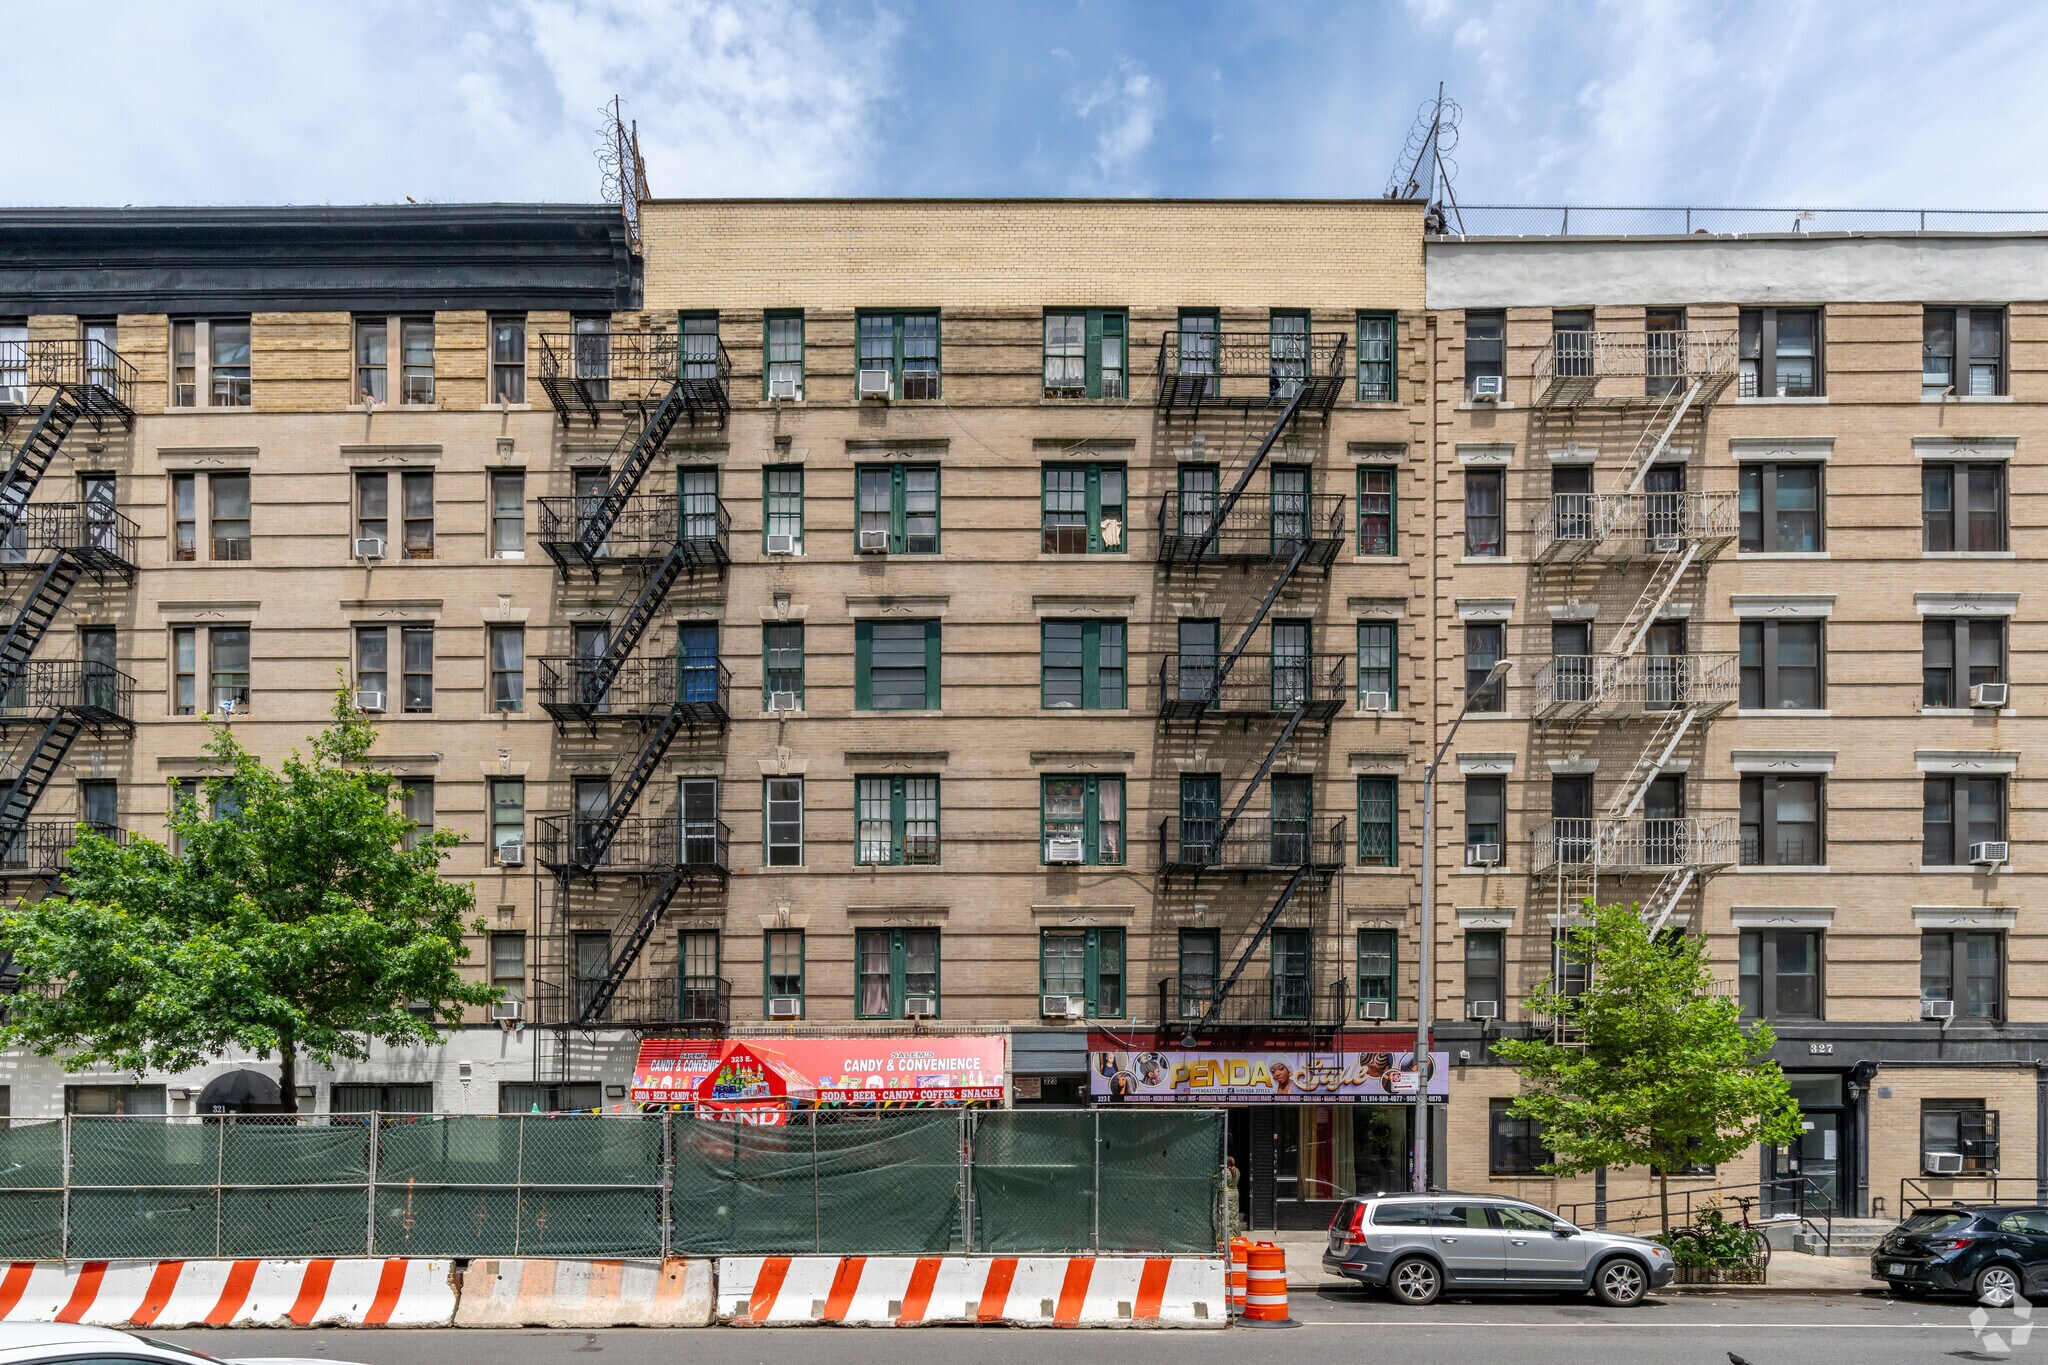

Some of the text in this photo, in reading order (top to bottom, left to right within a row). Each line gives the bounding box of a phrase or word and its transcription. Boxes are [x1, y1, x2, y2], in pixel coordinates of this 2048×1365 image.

[1810, 1044, 1833, 1053] 327
[650, 1060, 676, 1072] CANDY
[676, 1060, 682, 1072] &
[844, 1057, 981, 1072] CANDY & CONVENIENCE
[1169, 1059, 1274, 1089] PENDA
[1044, 1077, 1057, 1085] 323
[634, 1091, 650, 1100] SODA
[653, 1091, 667, 1100] BEER
[671, 1091, 690, 1100] CANDY
[821, 1089, 1000, 1101] SODA BEER CANDY COFFEE SNACKS
[212, 1105, 226, 1113] 321
